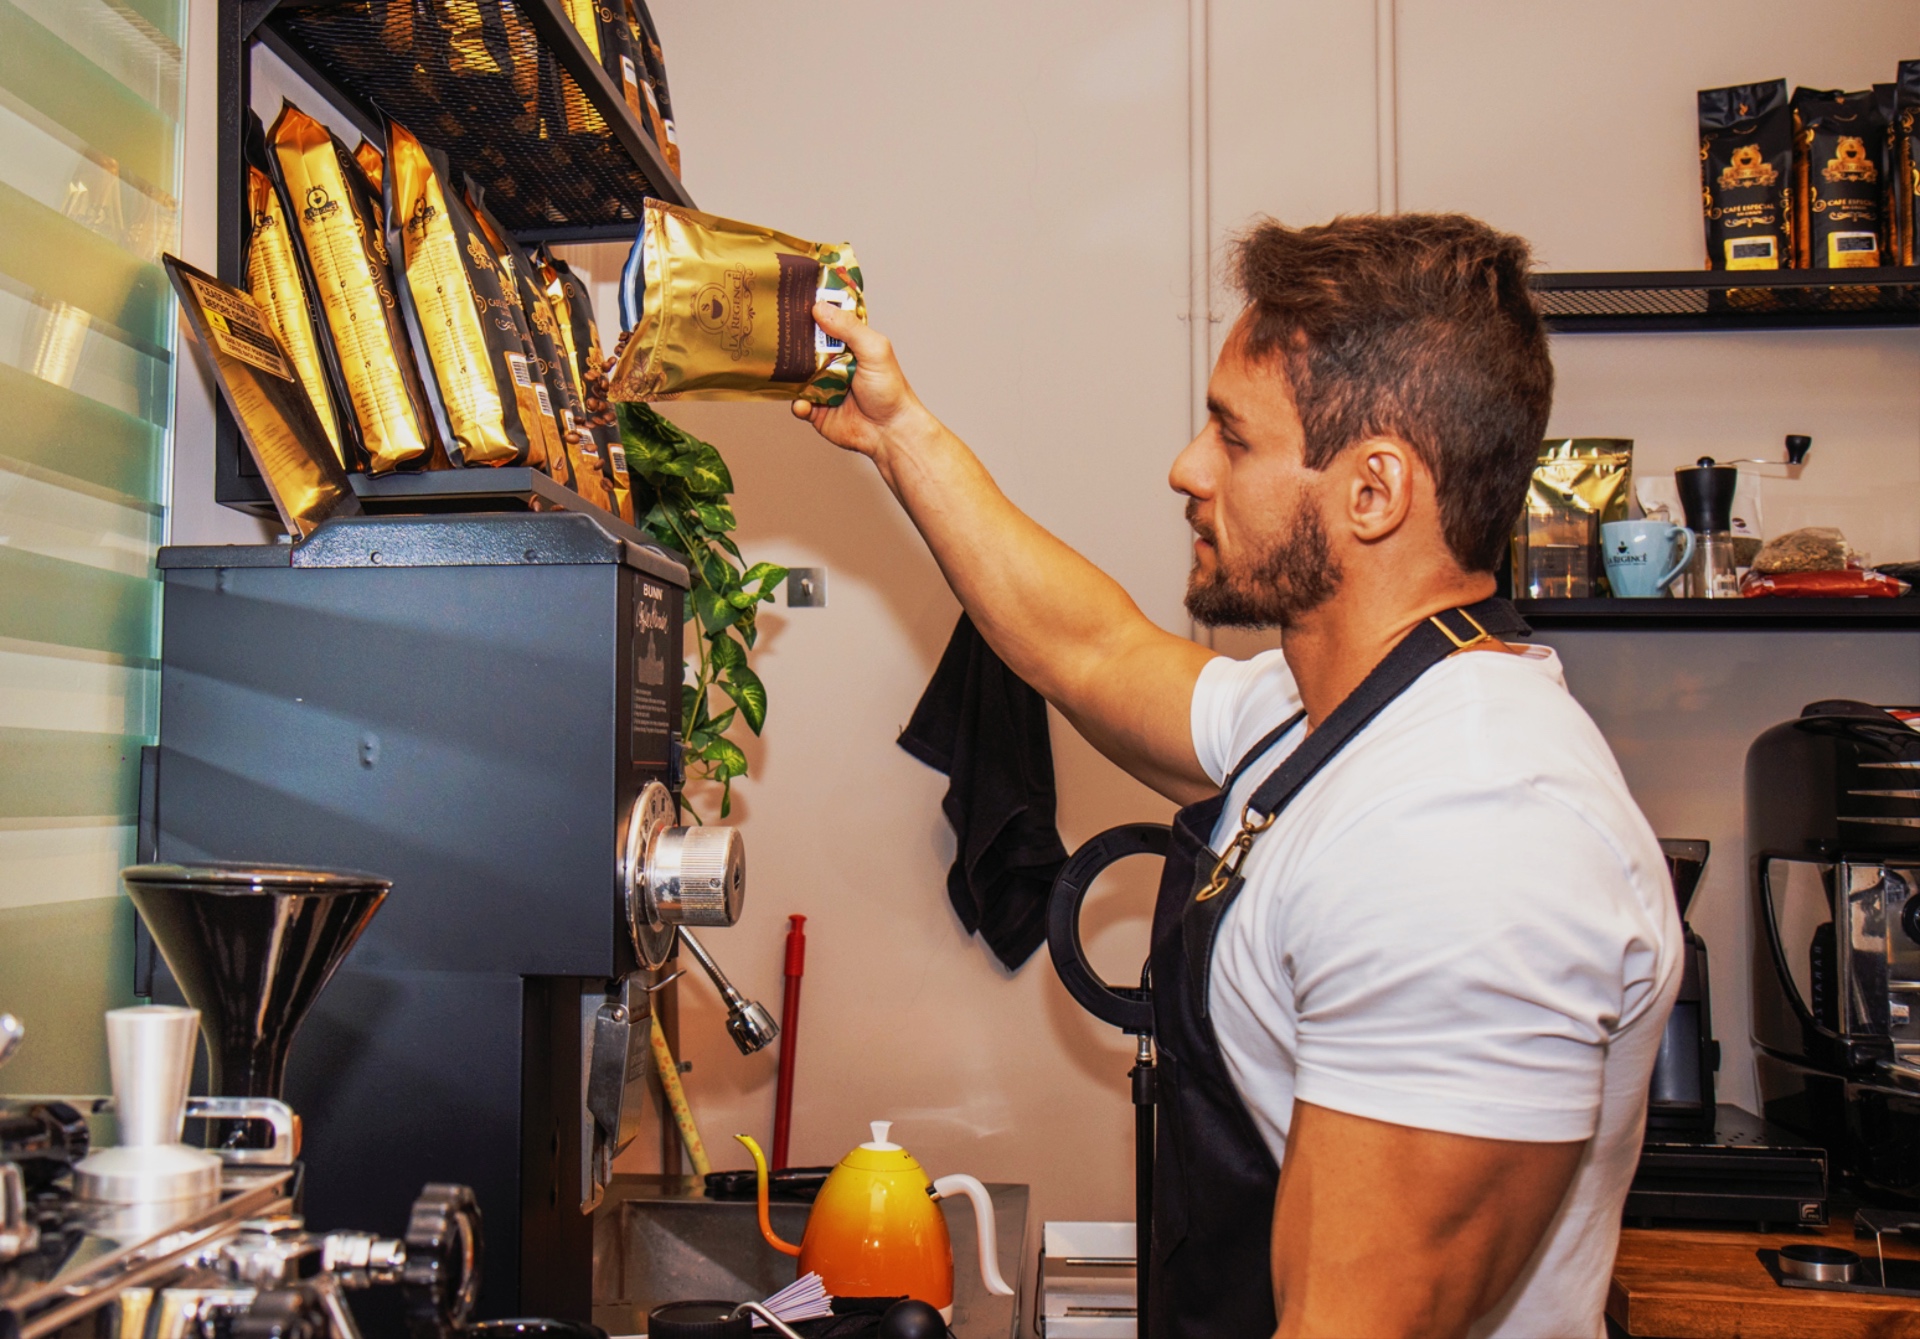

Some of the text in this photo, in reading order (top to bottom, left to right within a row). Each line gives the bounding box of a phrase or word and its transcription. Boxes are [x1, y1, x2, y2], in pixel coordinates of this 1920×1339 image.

[784, 297, 791, 309] EM
[729, 333, 739, 348] LA
[782, 348, 791, 370] CAFÉ
[643, 583, 663, 601] BUNN
